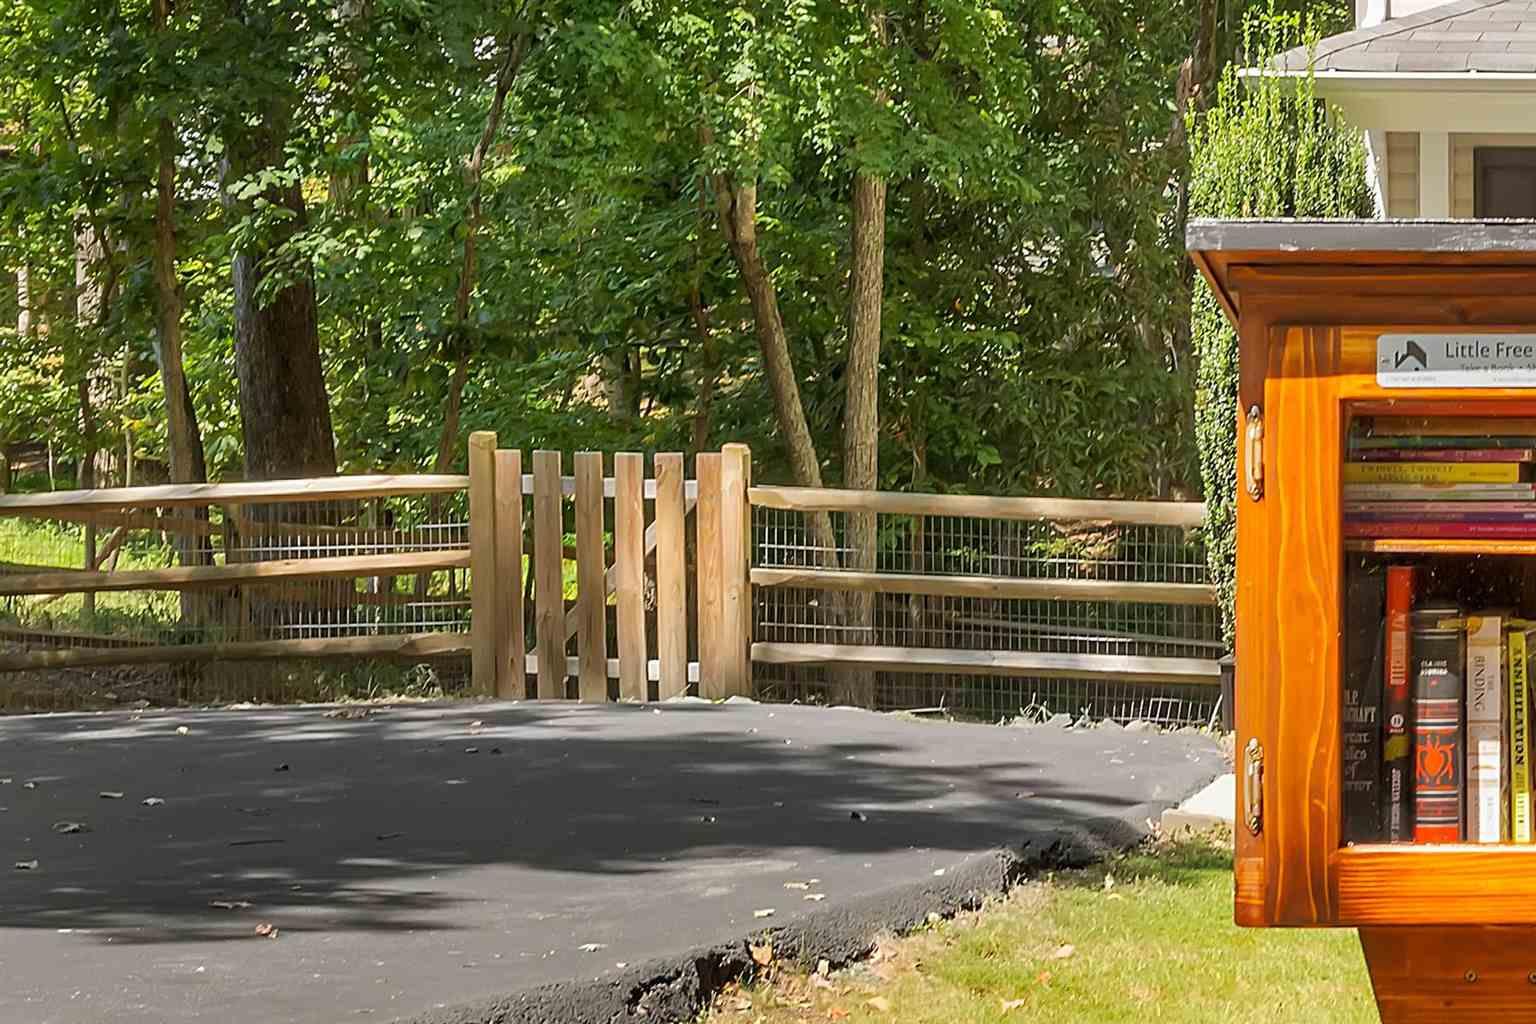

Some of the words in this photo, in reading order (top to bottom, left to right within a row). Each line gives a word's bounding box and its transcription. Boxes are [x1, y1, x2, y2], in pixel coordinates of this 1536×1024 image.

[1446, 341, 1490, 359] Little
[1496, 341, 1533, 359] Free
[1474, 655, 1486, 712] BINDING
[1512, 648, 1525, 765] ANNIHILATION
